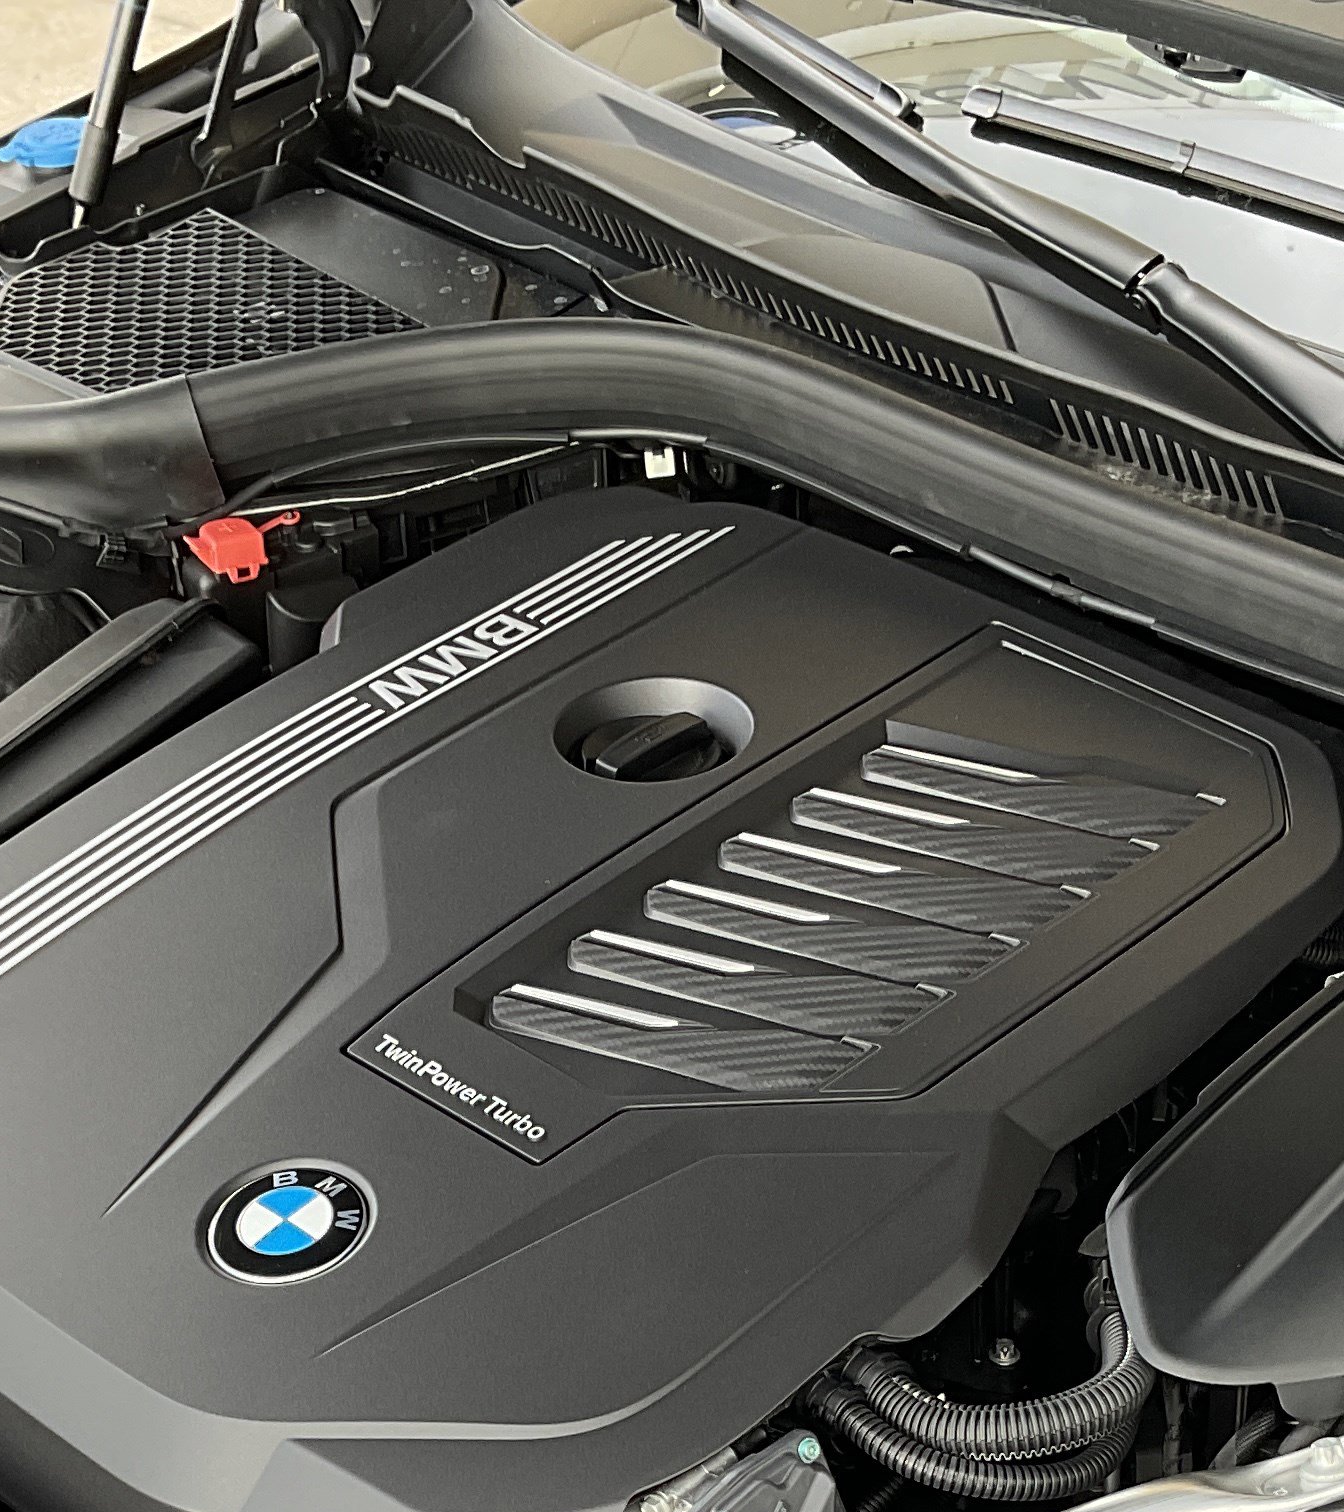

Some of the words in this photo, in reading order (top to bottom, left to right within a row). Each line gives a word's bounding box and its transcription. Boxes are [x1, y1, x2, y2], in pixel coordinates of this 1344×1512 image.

[369, 613, 540, 710] BMW
[375, 1033, 487, 1106] TwinPower
[483, 1095, 546, 1142] Turbo
[272, 1170, 361, 1231] BMW
